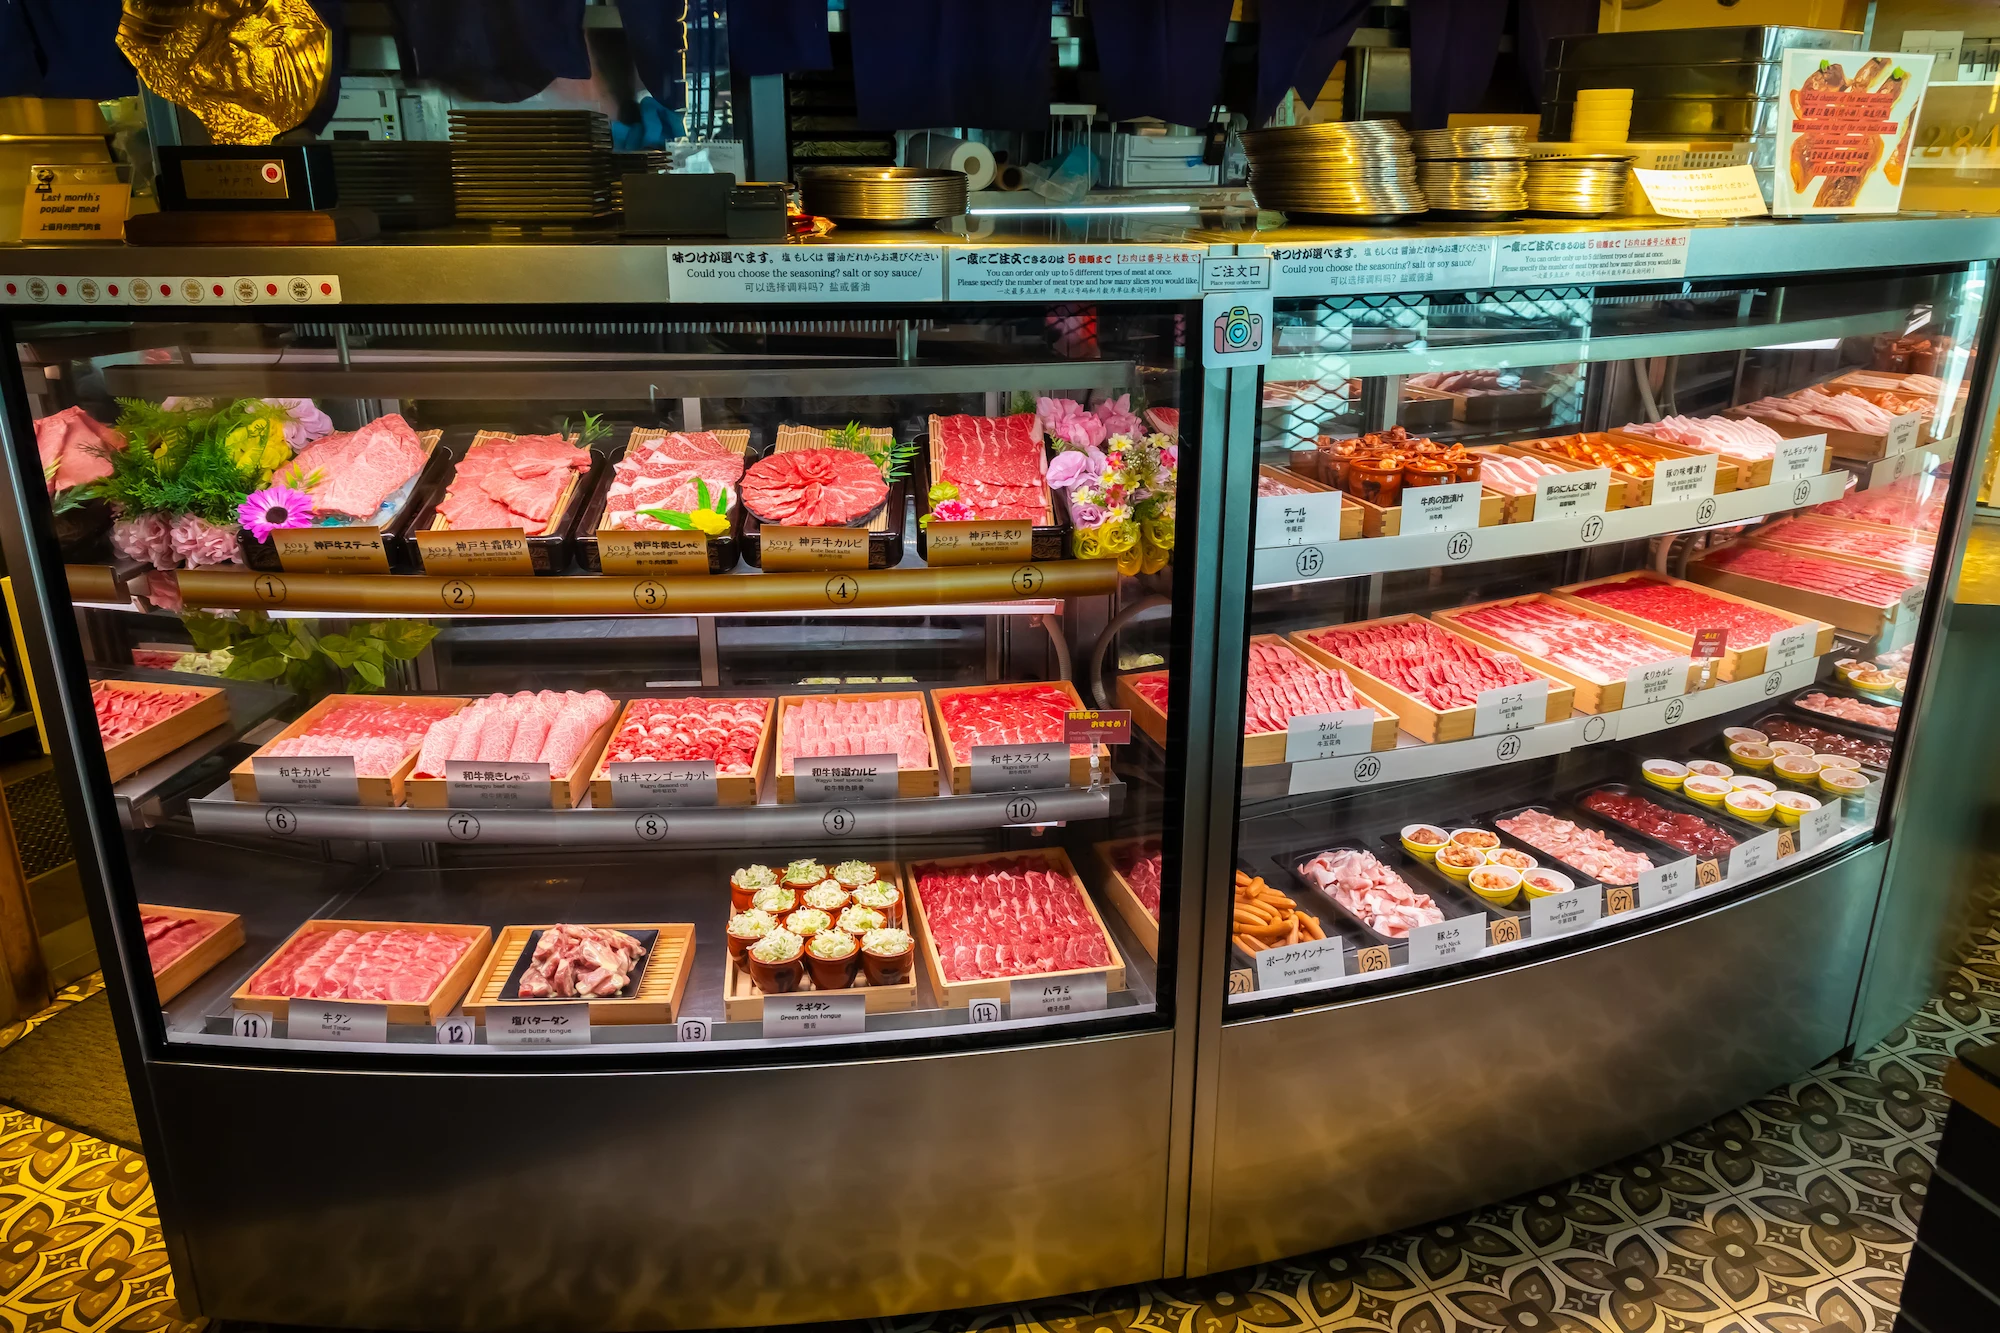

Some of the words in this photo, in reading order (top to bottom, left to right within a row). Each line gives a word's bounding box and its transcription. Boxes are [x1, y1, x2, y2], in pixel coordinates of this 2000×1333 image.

[41, 193, 61, 202] Last
[64, 192, 100, 202] month's
[40, 204, 75, 214] popular
[77, 204, 100, 213] meat
[1588, 239, 1595, 249] 5
[672, 251, 774, 264] 味つけが選べます。
[782, 252, 791, 262] 塩
[794, 252, 823, 262] もしくは
[955, 252, 1065, 265] 一度にご注文できるのは
[1067, 253, 1076, 264] 5
[1271, 247, 1357, 260] 味つけが選べます。
[687, 268, 715, 278] Could
[718, 270, 736, 279] you
[738, 268, 770, 278] choose
[772, 268, 788, 278] the
[790, 268, 840, 279] seasoning?
[843, 268, 859, 278] salt
[861, 270, 871, 278] or
[874, 270, 889, 279] soy
[892, 267, 923, 278] sauce/
[987, 269, 1000, 277] You
[1015, 269, 1033, 277] order
[1034, 269, 1049, 278] only
[1051, 270, 1060, 278] up
[1061, 269, 1069, 277] to
[1075, 268, 1104, 277] different
[1105, 269, 1122, 277] types
[1123, 268, 1131, 277] of
[1132, 268, 1146, 276] meat
[1147, 268, 1155, 276] at
[1211, 264, 1260, 278] ご注文口
[1282, 264, 1307, 274] Could
[1309, 265, 1324, 274] you
[1325, 262, 1353, 273] choose
[1355, 262, 1368, 271] the
[1369, 260, 1411, 271] seasoning?
[1412, 260, 1426, 269] salt
[1437, 261, 1449, 269] soy
[1451, 258, 1476, 267] sauce/
[980, 279, 1004, 287] specify
[1005, 278, 1016, 286] the
[1017, 278, 1042, 286] number
[1043, 277, 1051, 286] of
[1053, 278, 1068, 286] meat
[1069, 278, 1084, 287] type
[1099, 277, 1112, 285] how
[1114, 278, 1131, 286] many
[1132, 277, 1150, 285] slices
[1151, 278, 1164, 286] you
[1796, 486, 1808, 501] 19
[1284, 507, 1306, 516] テール
[1699, 504, 1712, 520] 18
[1584, 522, 1600, 537] 17
[313, 540, 380, 550] 神戸牛ステーキ
[456, 539, 522, 551] 神戸牛霜降り
[798, 536, 863, 548] 神戸牛カルビ
[1451, 538, 1468, 555] 16
[1301, 554, 1318, 571] 15
[1023, 573, 1033, 589] 5
[265, 581, 276, 598] 1
[453, 587, 465, 604] 2
[645, 587, 657, 604] 3
[836, 582, 848, 598] 4
[1766, 678, 1780, 692] 23
[1501, 693, 1523, 704] ロース
[1667, 704, 1681, 720] 22
[1318, 720, 1343, 731] カルビ
[1501, 741, 1516, 756] 21
[990, 752, 1051, 765] 和牛スライス
[279, 767, 331, 778] 和牛カルビ
[618, 771, 709, 783] 和牛マンゴーカット
[812, 767, 877, 777] 和牛特選カルビ
[1357, 762, 1377, 778] 20
[1011, 802, 1031, 818] 10
[276, 813, 288, 829] 6
[458, 820, 469, 835] 7
[646, 820, 657, 835] 8
[833, 815, 845, 830] 9
[1780, 840, 1790, 855] 29
[1704, 869, 1716, 884] 28
[1557, 898, 1578, 910] ギアラ
[1613, 896, 1628, 911] 27
[1437, 929, 1460, 941] 豚とろ
[1498, 927, 1515, 943] 26
[1435, 943, 1448, 951] Pork
[1266, 946, 1335, 967] ポークウインナー
[1366, 955, 1384, 972] 25
[1284, 969, 1297, 977] Pork
[1298, 965, 1320, 975] sausage
[1043, 985, 1070, 996] ハラミ
[1230, 978, 1246, 994] 24
[796, 1003, 831, 1012] ネギタン
[976, 1007, 992, 1021] 14
[322, 1012, 352, 1024] 牛タン
[511, 1016, 569, 1026] 塩バタータン
[243, 1019, 258, 1037] 11
[448, 1025, 464, 1043] 12
[685, 1027, 701, 1039] 13
